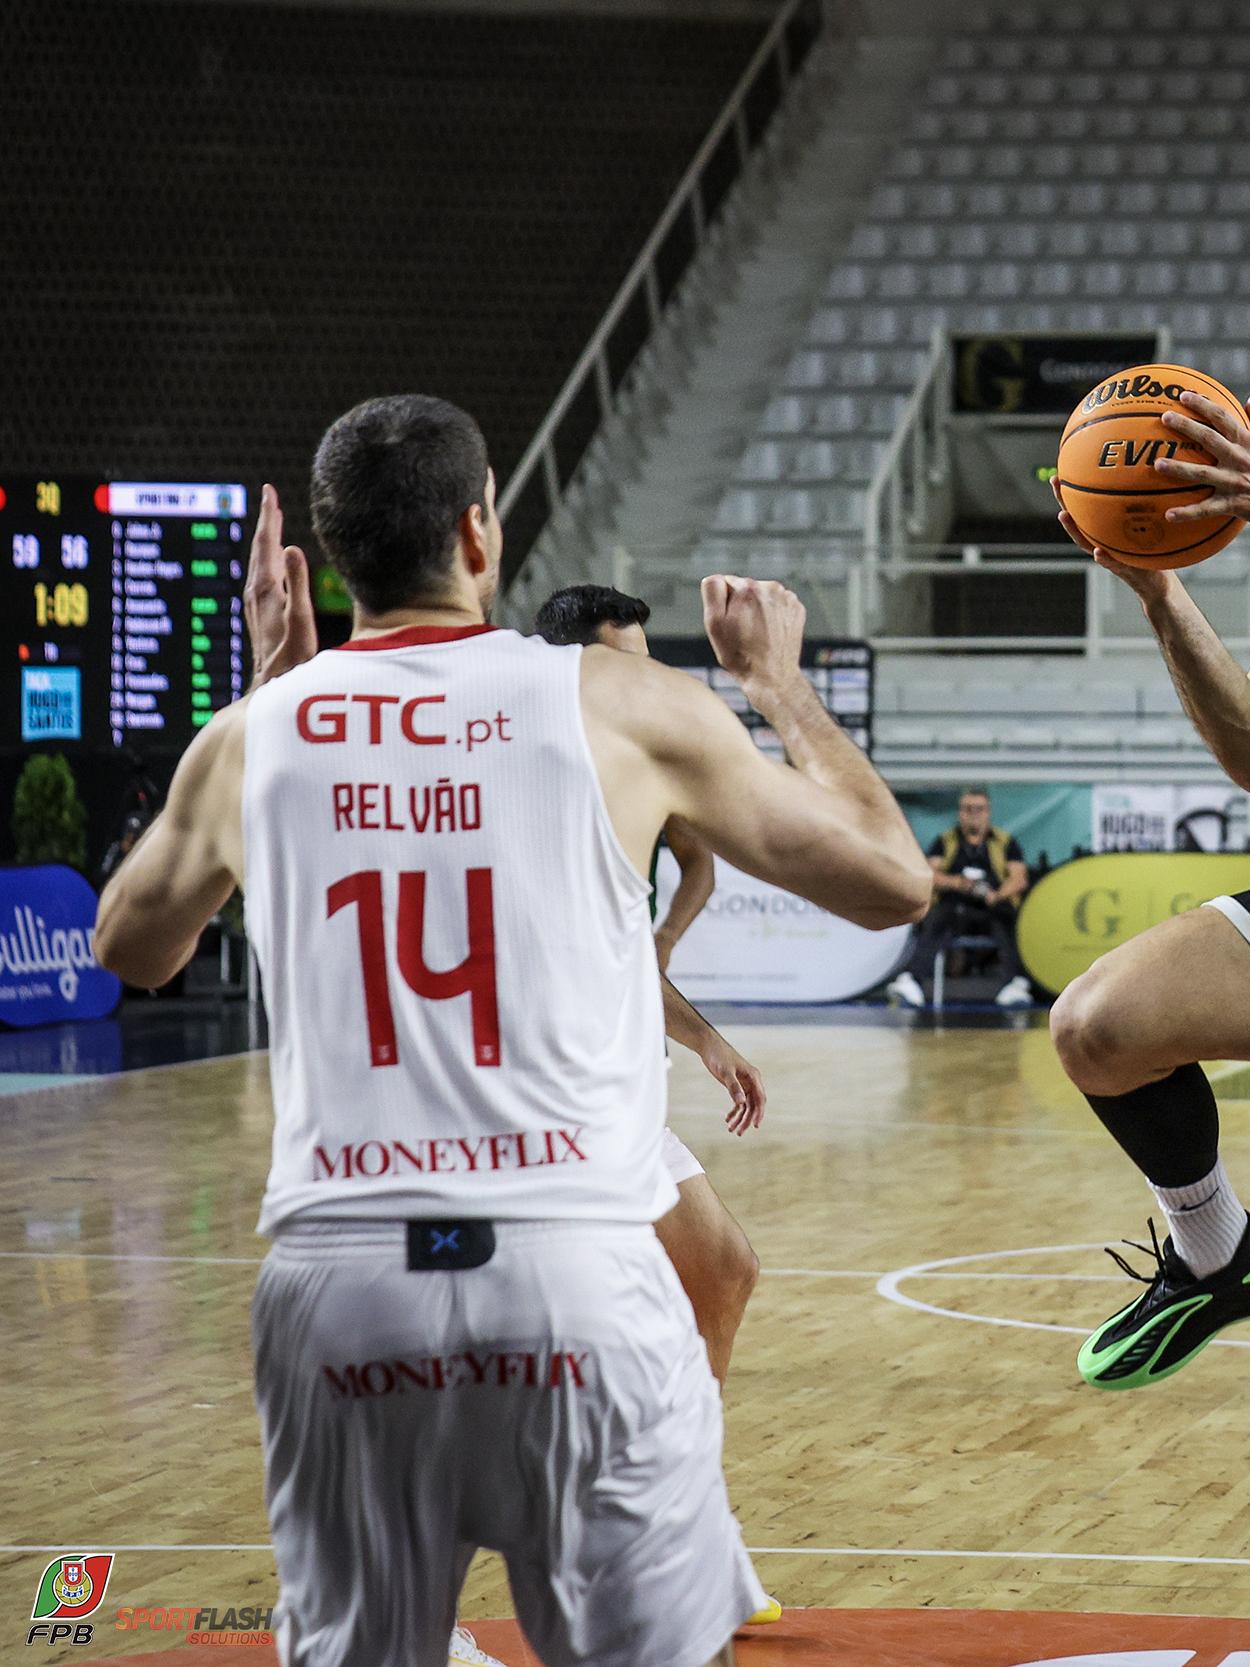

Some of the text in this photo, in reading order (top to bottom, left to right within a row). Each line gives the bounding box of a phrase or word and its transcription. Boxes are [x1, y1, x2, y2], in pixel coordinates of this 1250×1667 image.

[1082, 375, 1212, 414] Wilso
[34, 582, 89, 627] 1:09
[296, 693, 513, 752] GTC.pt
[333, 778, 481, 834] RELVÃO
[1073, 887, 1121, 938] G
[0, 905, 97, 1003] ulliga
[326, 867, 501, 1068] 14
[312, 1128, 588, 1182] MONEYFLIX
[322, 1351, 589, 1399] MONEYFLIX
